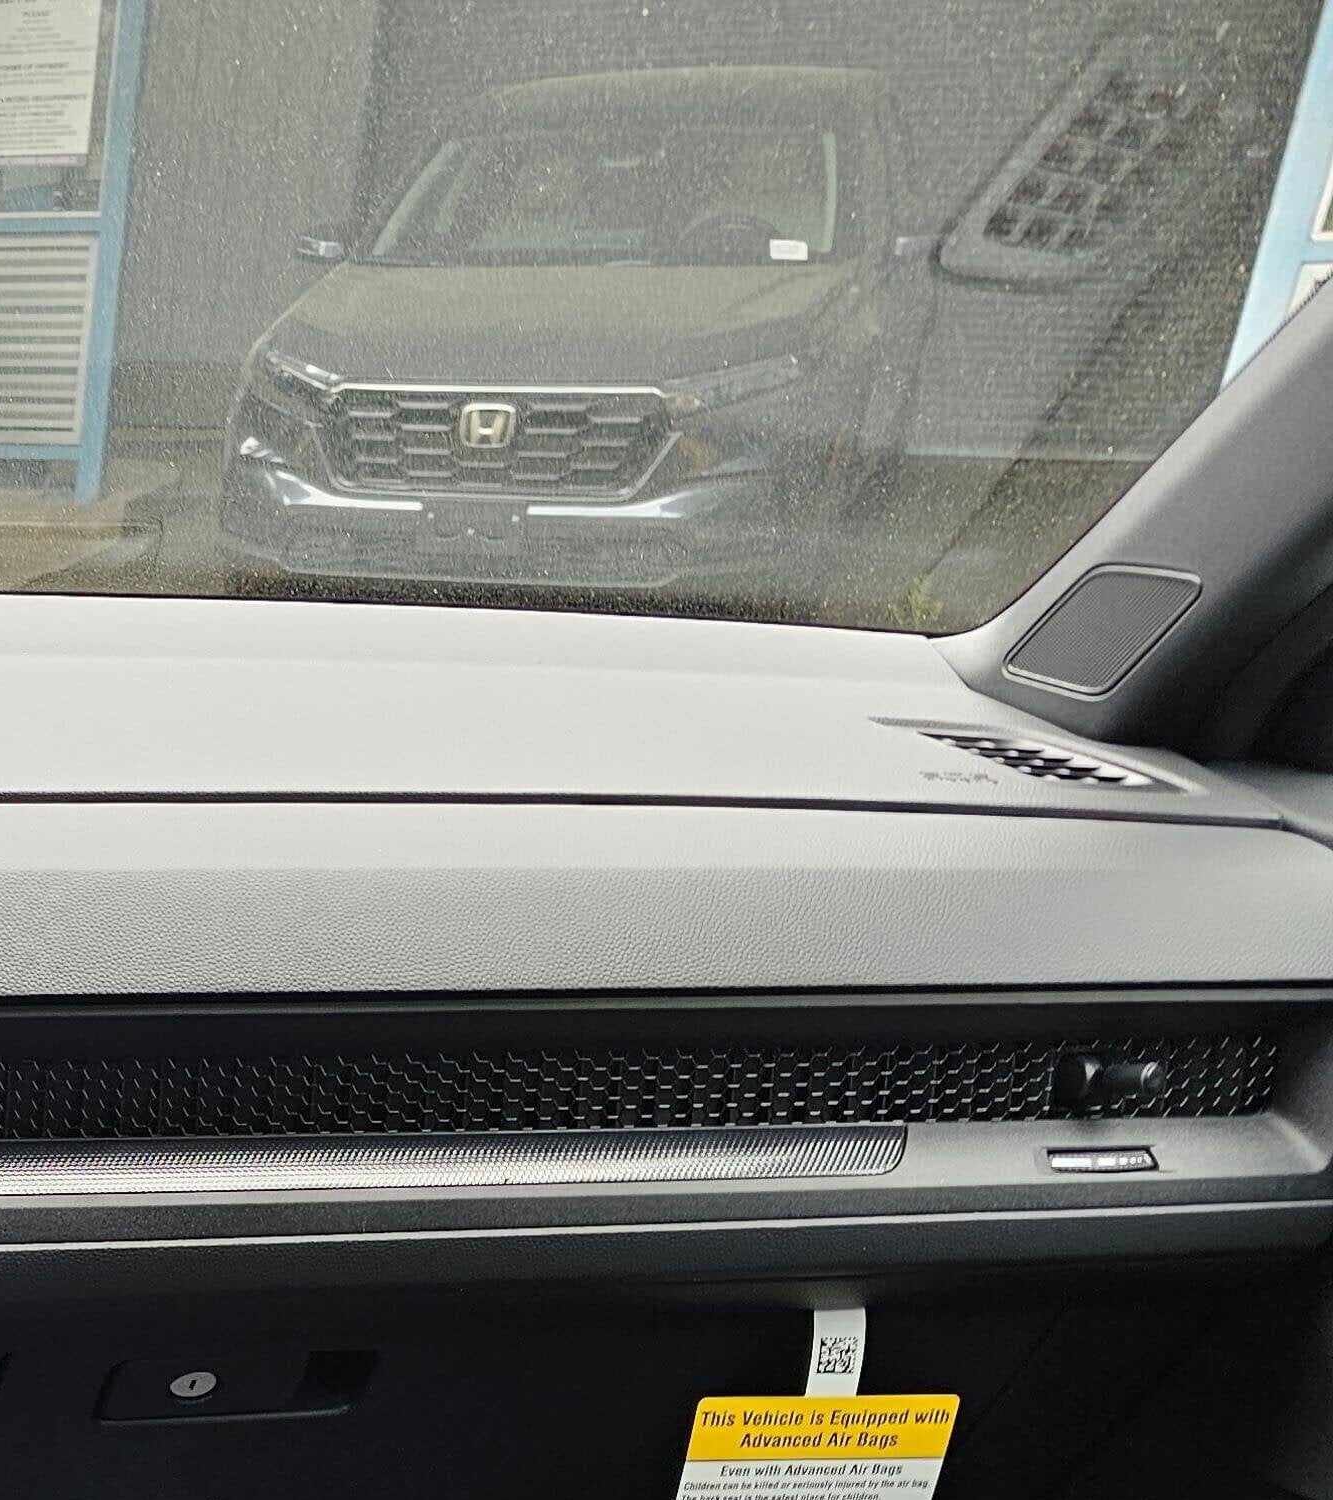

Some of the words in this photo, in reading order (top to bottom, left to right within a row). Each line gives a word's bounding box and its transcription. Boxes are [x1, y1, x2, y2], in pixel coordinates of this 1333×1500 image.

[702, 1411, 735, 1427] This
[743, 1410, 804, 1426] Vehicle
[810, 1410, 824, 1425] is
[829, 1409, 910, 1428] Equipped
[914, 1408, 950, 1424] with
[740, 1432, 822, 1448] Advanced
[827, 1432, 852, 1447] Air
[857, 1431, 899, 1450] Bags
[720, 1465, 750, 1478] Even
[755, 1464, 781, 1477] with
[784, 1464, 847, 1476] Advanced
[849, 1464, 869, 1475] Air
[871, 1463, 903, 1478] Bags
[684, 1481, 720, 1491] Children
[741, 1481, 751, 1490] be
[754, 1481, 779, 1489] killed
[792, 1480, 833, 1490] seriously
[835, 1480, 866, 1490] injured
[868, 1480, 877, 1489] by
[880, 1479, 894, 1488] the
[897, 1479, 909, 1488] air
[912, 1479, 931, 1489] bag.
